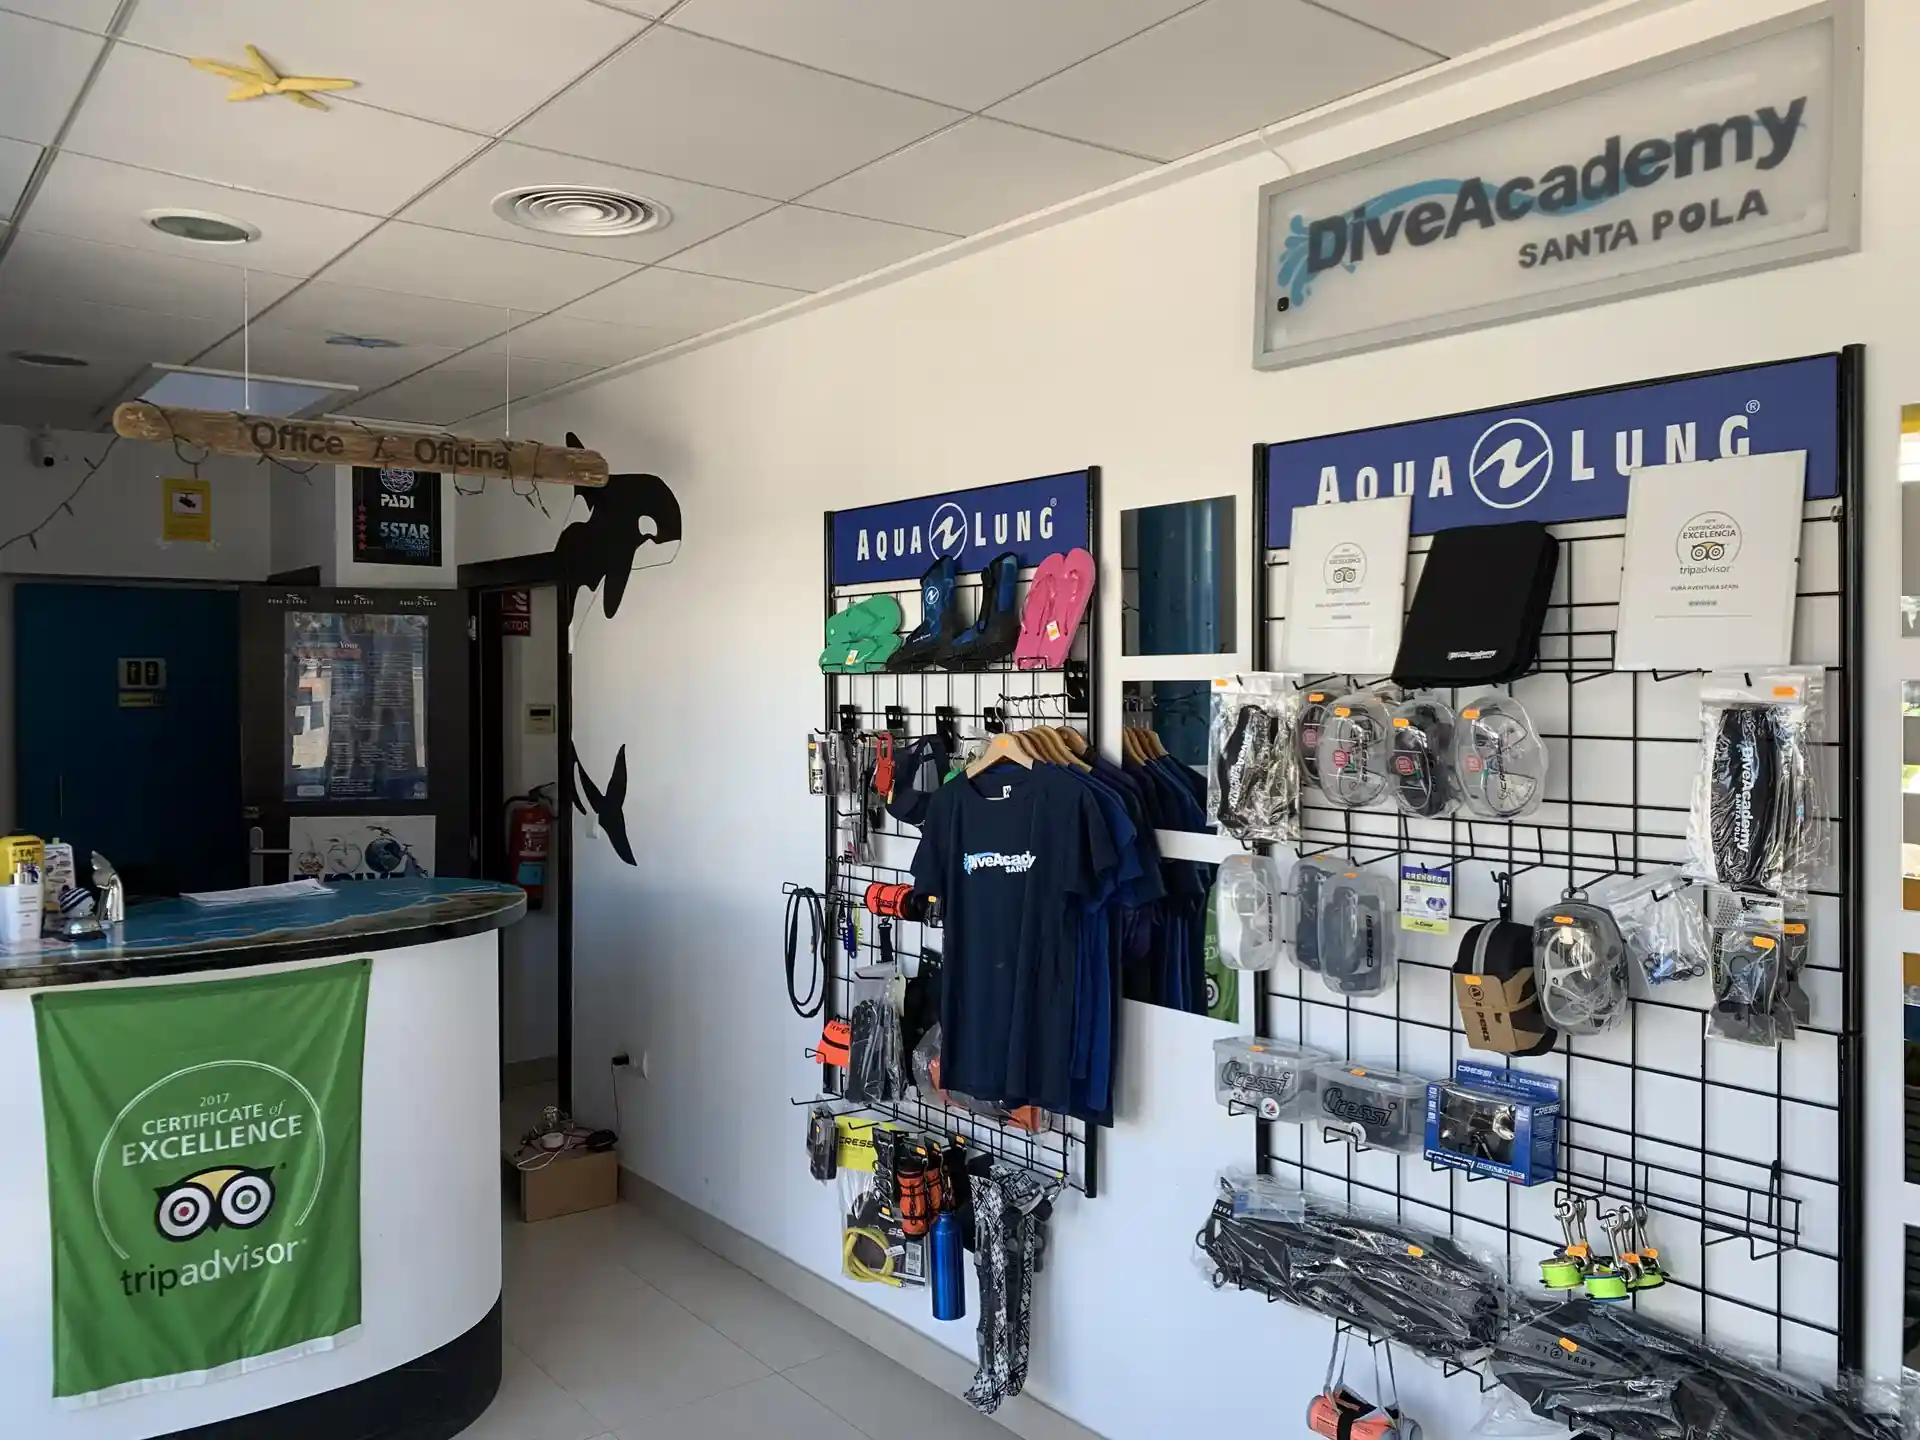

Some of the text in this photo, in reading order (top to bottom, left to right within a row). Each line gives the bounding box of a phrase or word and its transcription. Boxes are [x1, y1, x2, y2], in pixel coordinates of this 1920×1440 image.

[1308, 96, 1807, 273] DiveAcademy
[1518, 189, 1768, 269] SANTA POLA
[251, 421, 510, 471] Office Oficina
[1317, 414, 1750, 505] AQUA LUNG
[380, 493, 415, 509] PADI
[857, 506, 1054, 561] AQUA LUNG
[1682, 529, 1736, 539] EXCELENCIA
[1679, 564, 1731, 576] tripadvisor
[1737, 745, 1755, 852] DiveAcademy
[1713, 931, 1723, 985] CRESSI
[1221, 1060, 1292, 1095] Cressi
[1457, 1064, 1492, 1078] CRESSI
[142, 1099, 286, 1136] CERTIFICATE of
[199, 1093, 230, 1107] 2017
[1323, 1087, 1397, 1126] Cressi
[122, 1115, 303, 1167] EXCELLENCE
[1214, 1203, 1232, 1216] AQUA
[120, 1240, 299, 1297] tripadvisor
[1567, 1353, 1596, 1369] AQUA
